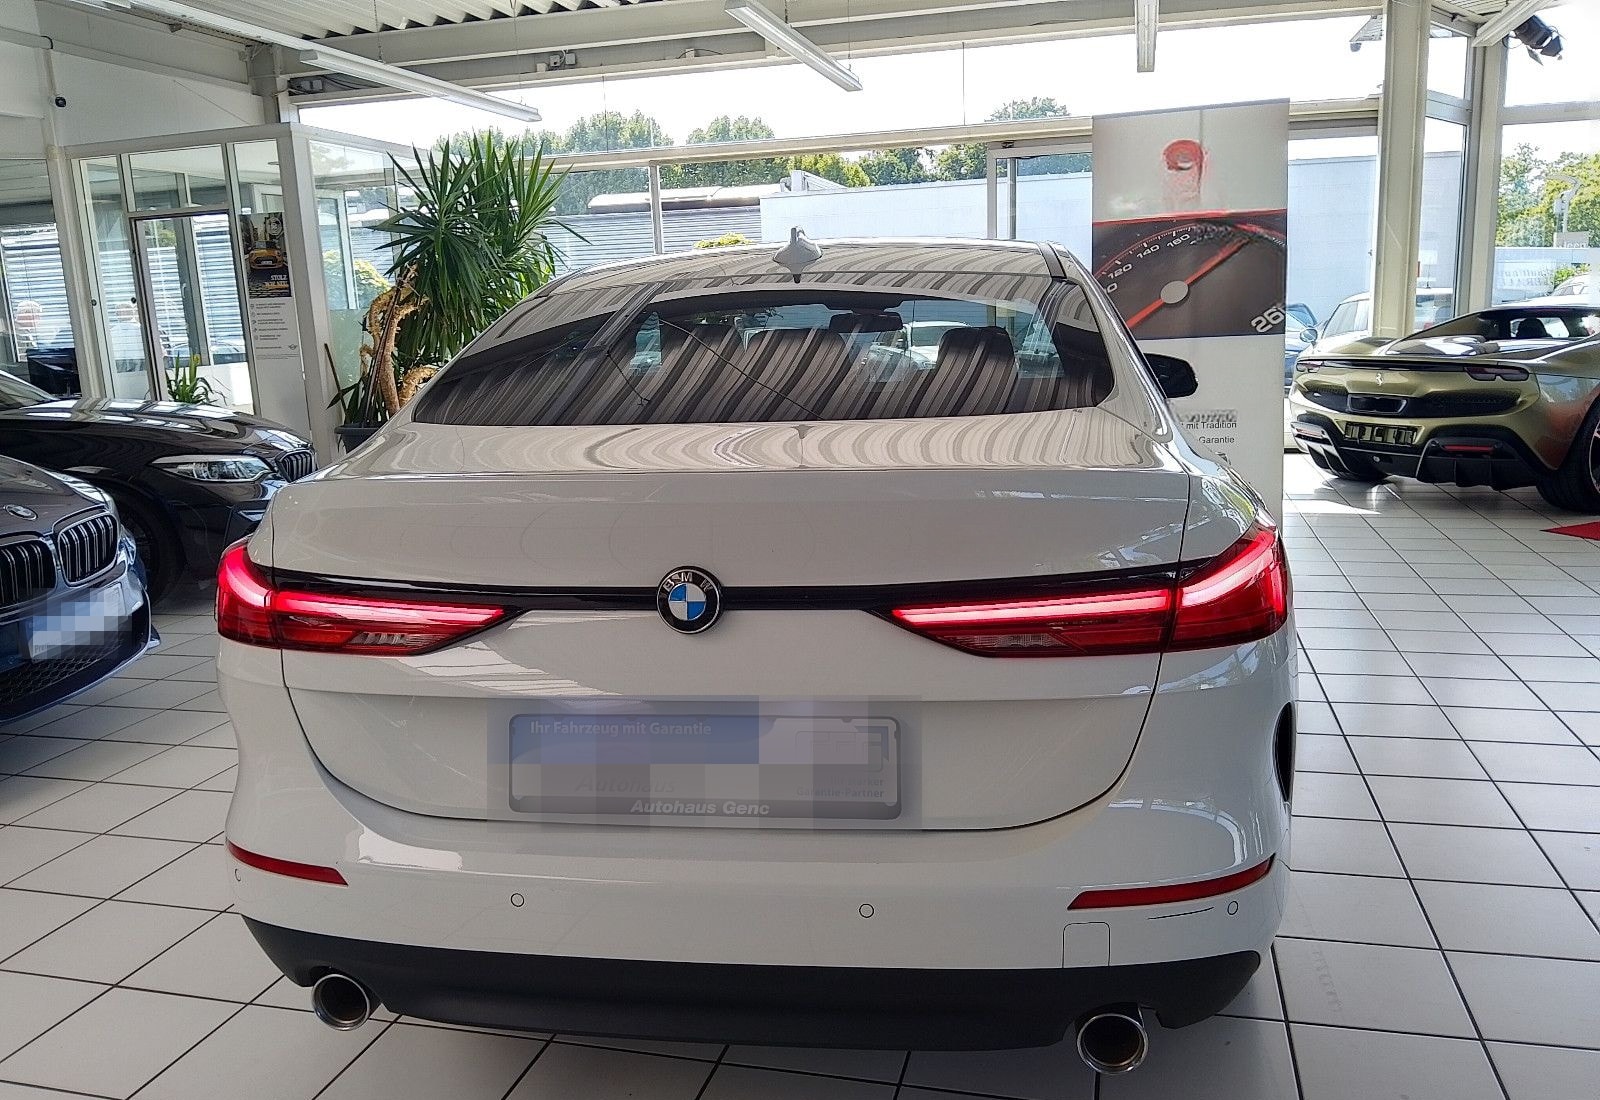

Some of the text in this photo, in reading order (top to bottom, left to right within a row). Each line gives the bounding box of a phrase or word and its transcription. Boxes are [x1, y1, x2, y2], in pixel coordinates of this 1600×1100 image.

[1166, 233, 1191, 248] 160
[1136, 244, 1161, 259] 140
[1107, 263, 1133, 280] 120
[1250, 306, 1286, 333] 26
[1186, 421, 1237, 430] mit Tradition
[1198, 436, 1235, 444] Garantie
[662, 571, 714, 593] BMW
[530, 721, 712, 738] Ihr Fahrzeug mit Garantie
[630, 799, 770, 816] Autohaus Genc
